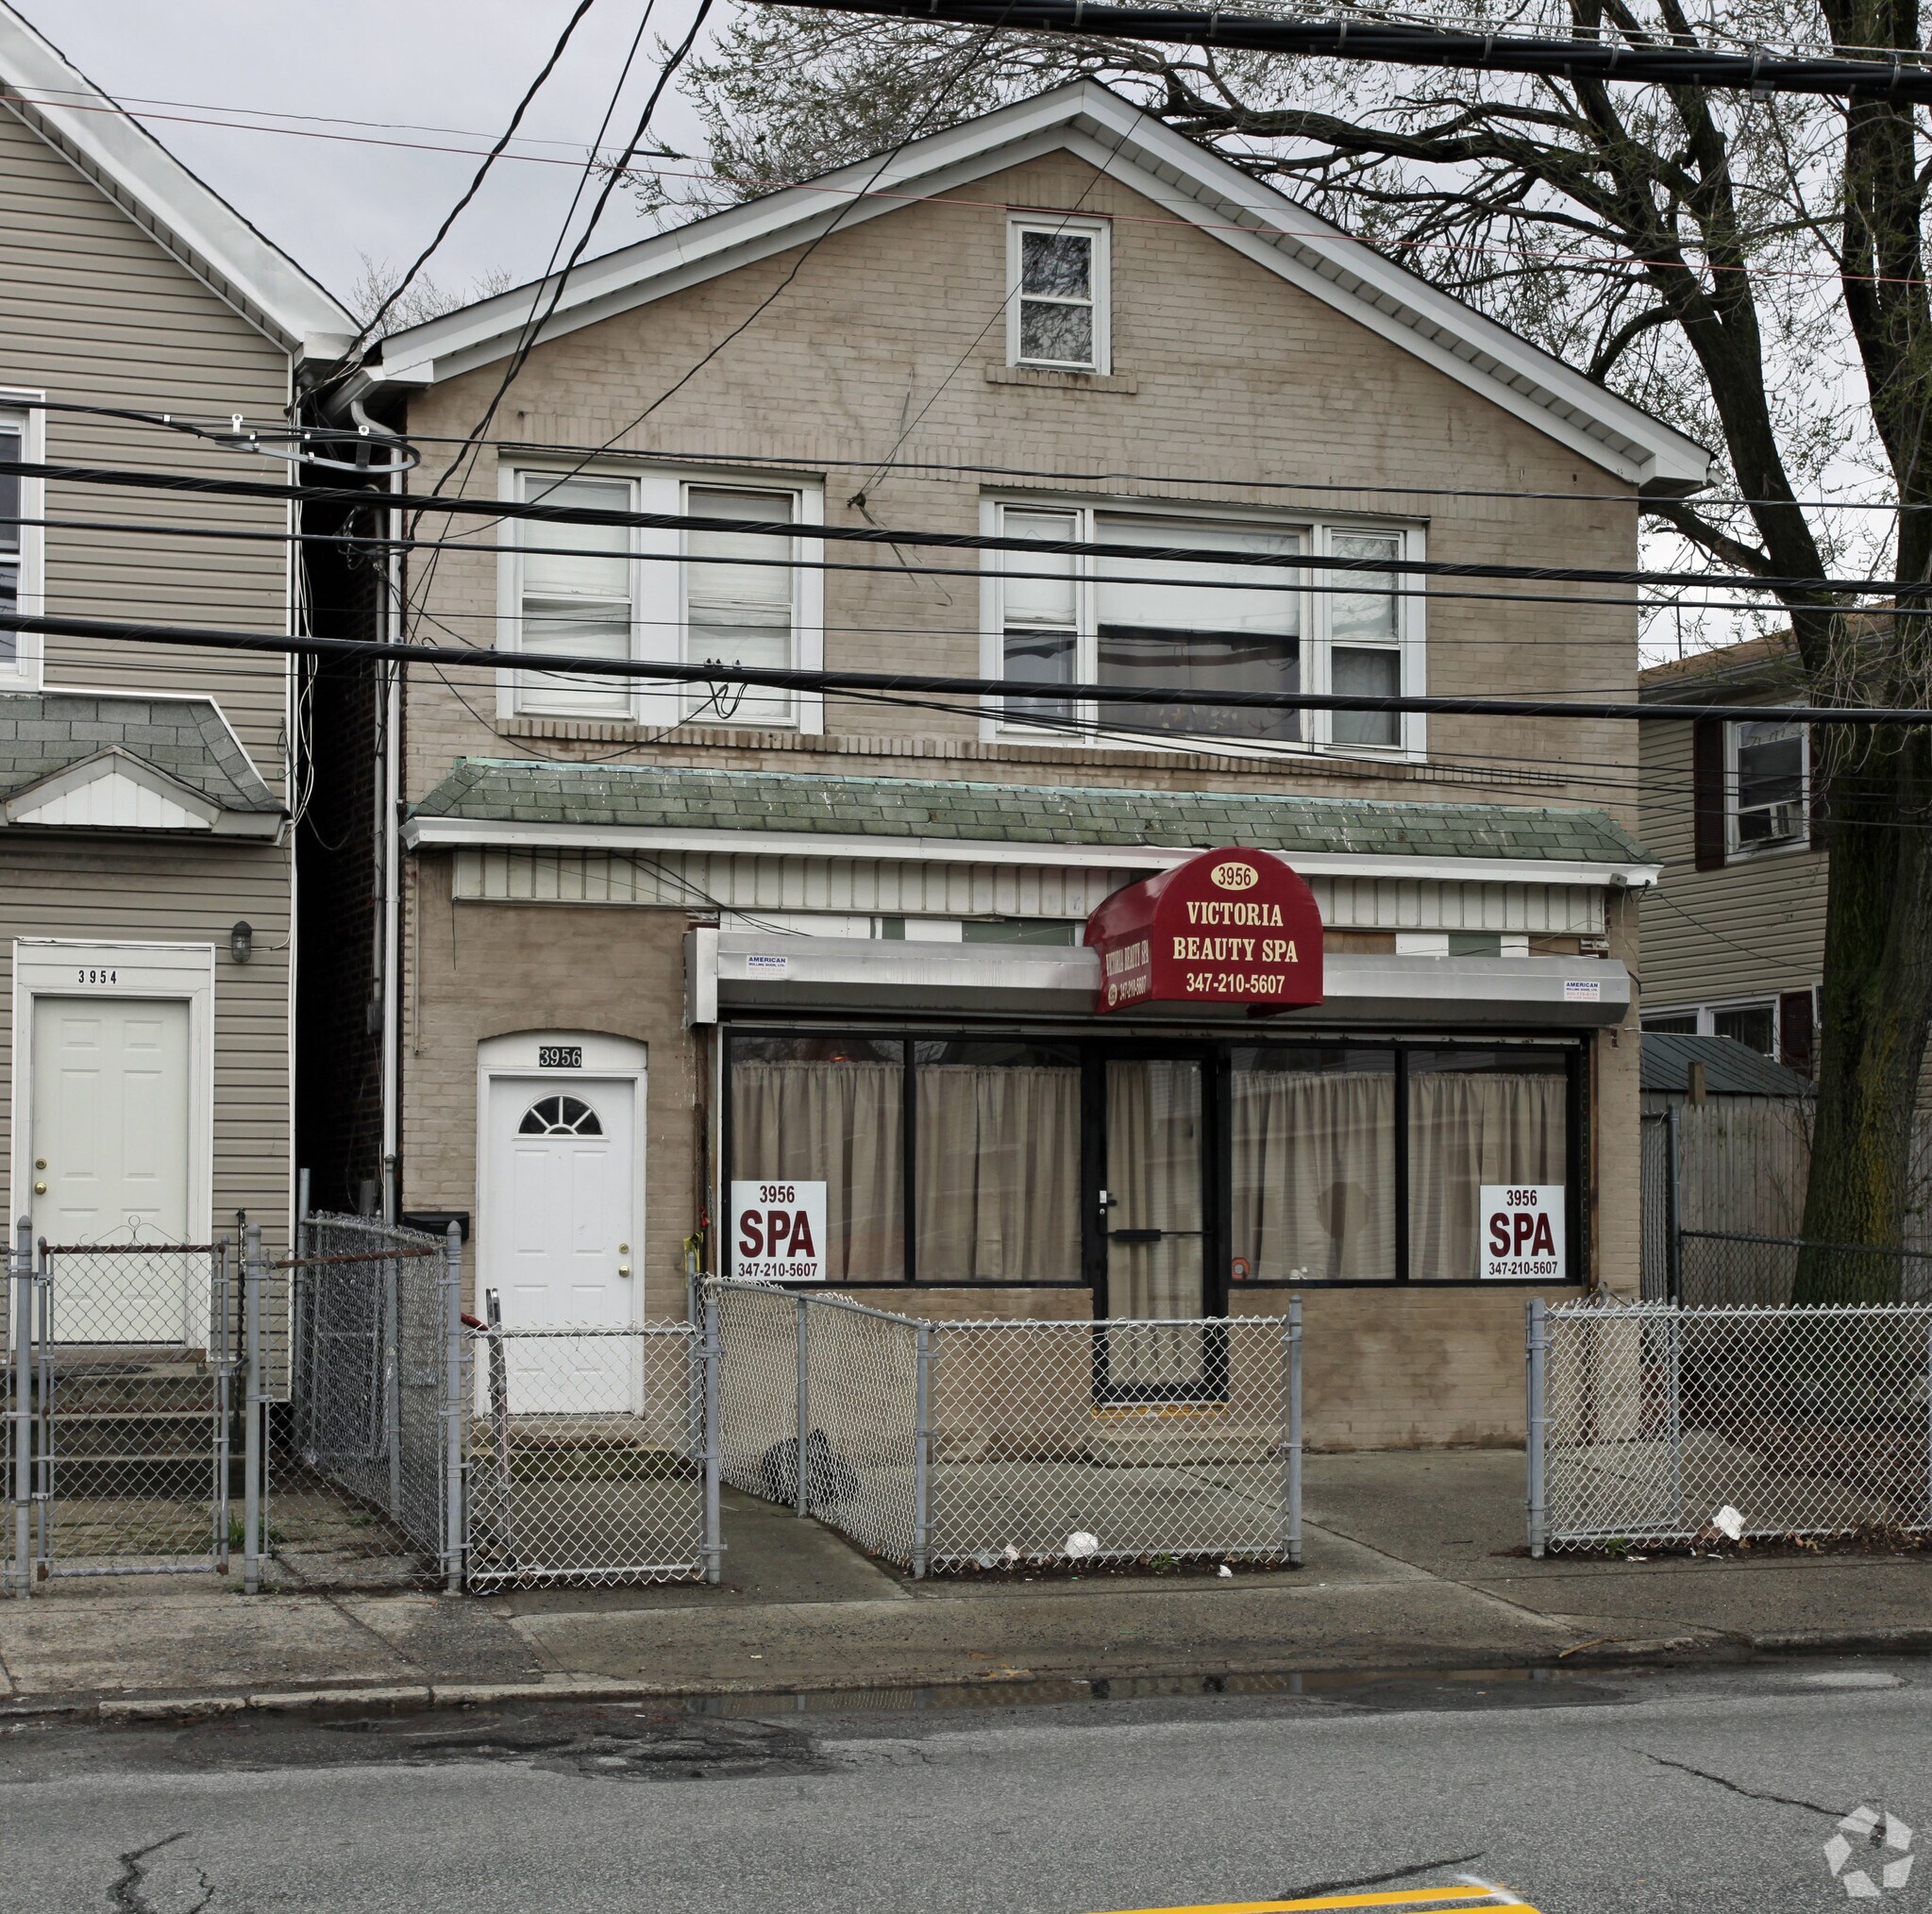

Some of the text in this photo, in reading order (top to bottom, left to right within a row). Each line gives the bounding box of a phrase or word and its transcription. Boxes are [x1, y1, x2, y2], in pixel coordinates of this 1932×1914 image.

[1218, 866, 1252, 886] 3956
[1186, 901, 1284, 927] VICTORIA
[1124, 942, 1140, 971] BEAUTY
[1141, 939, 1150, 965] SPA
[1172, 936, 1298, 963] BEAUTY SPA
[78, 969, 117, 983] 3954
[1186, 972, 1285, 994] 347-210-5607
[540, 1049, 581, 1066] 3956
[760, 1185, 795, 1203] 3956
[1506, 1189, 1537, 1206] 3956
[739, 1209, 815, 1258] SPA
[1489, 1212, 1555, 1257] SPA
[738, 1263, 817, 1277] 347-210-5607
[1488, 1262, 1558, 1275] 347-210-5607
